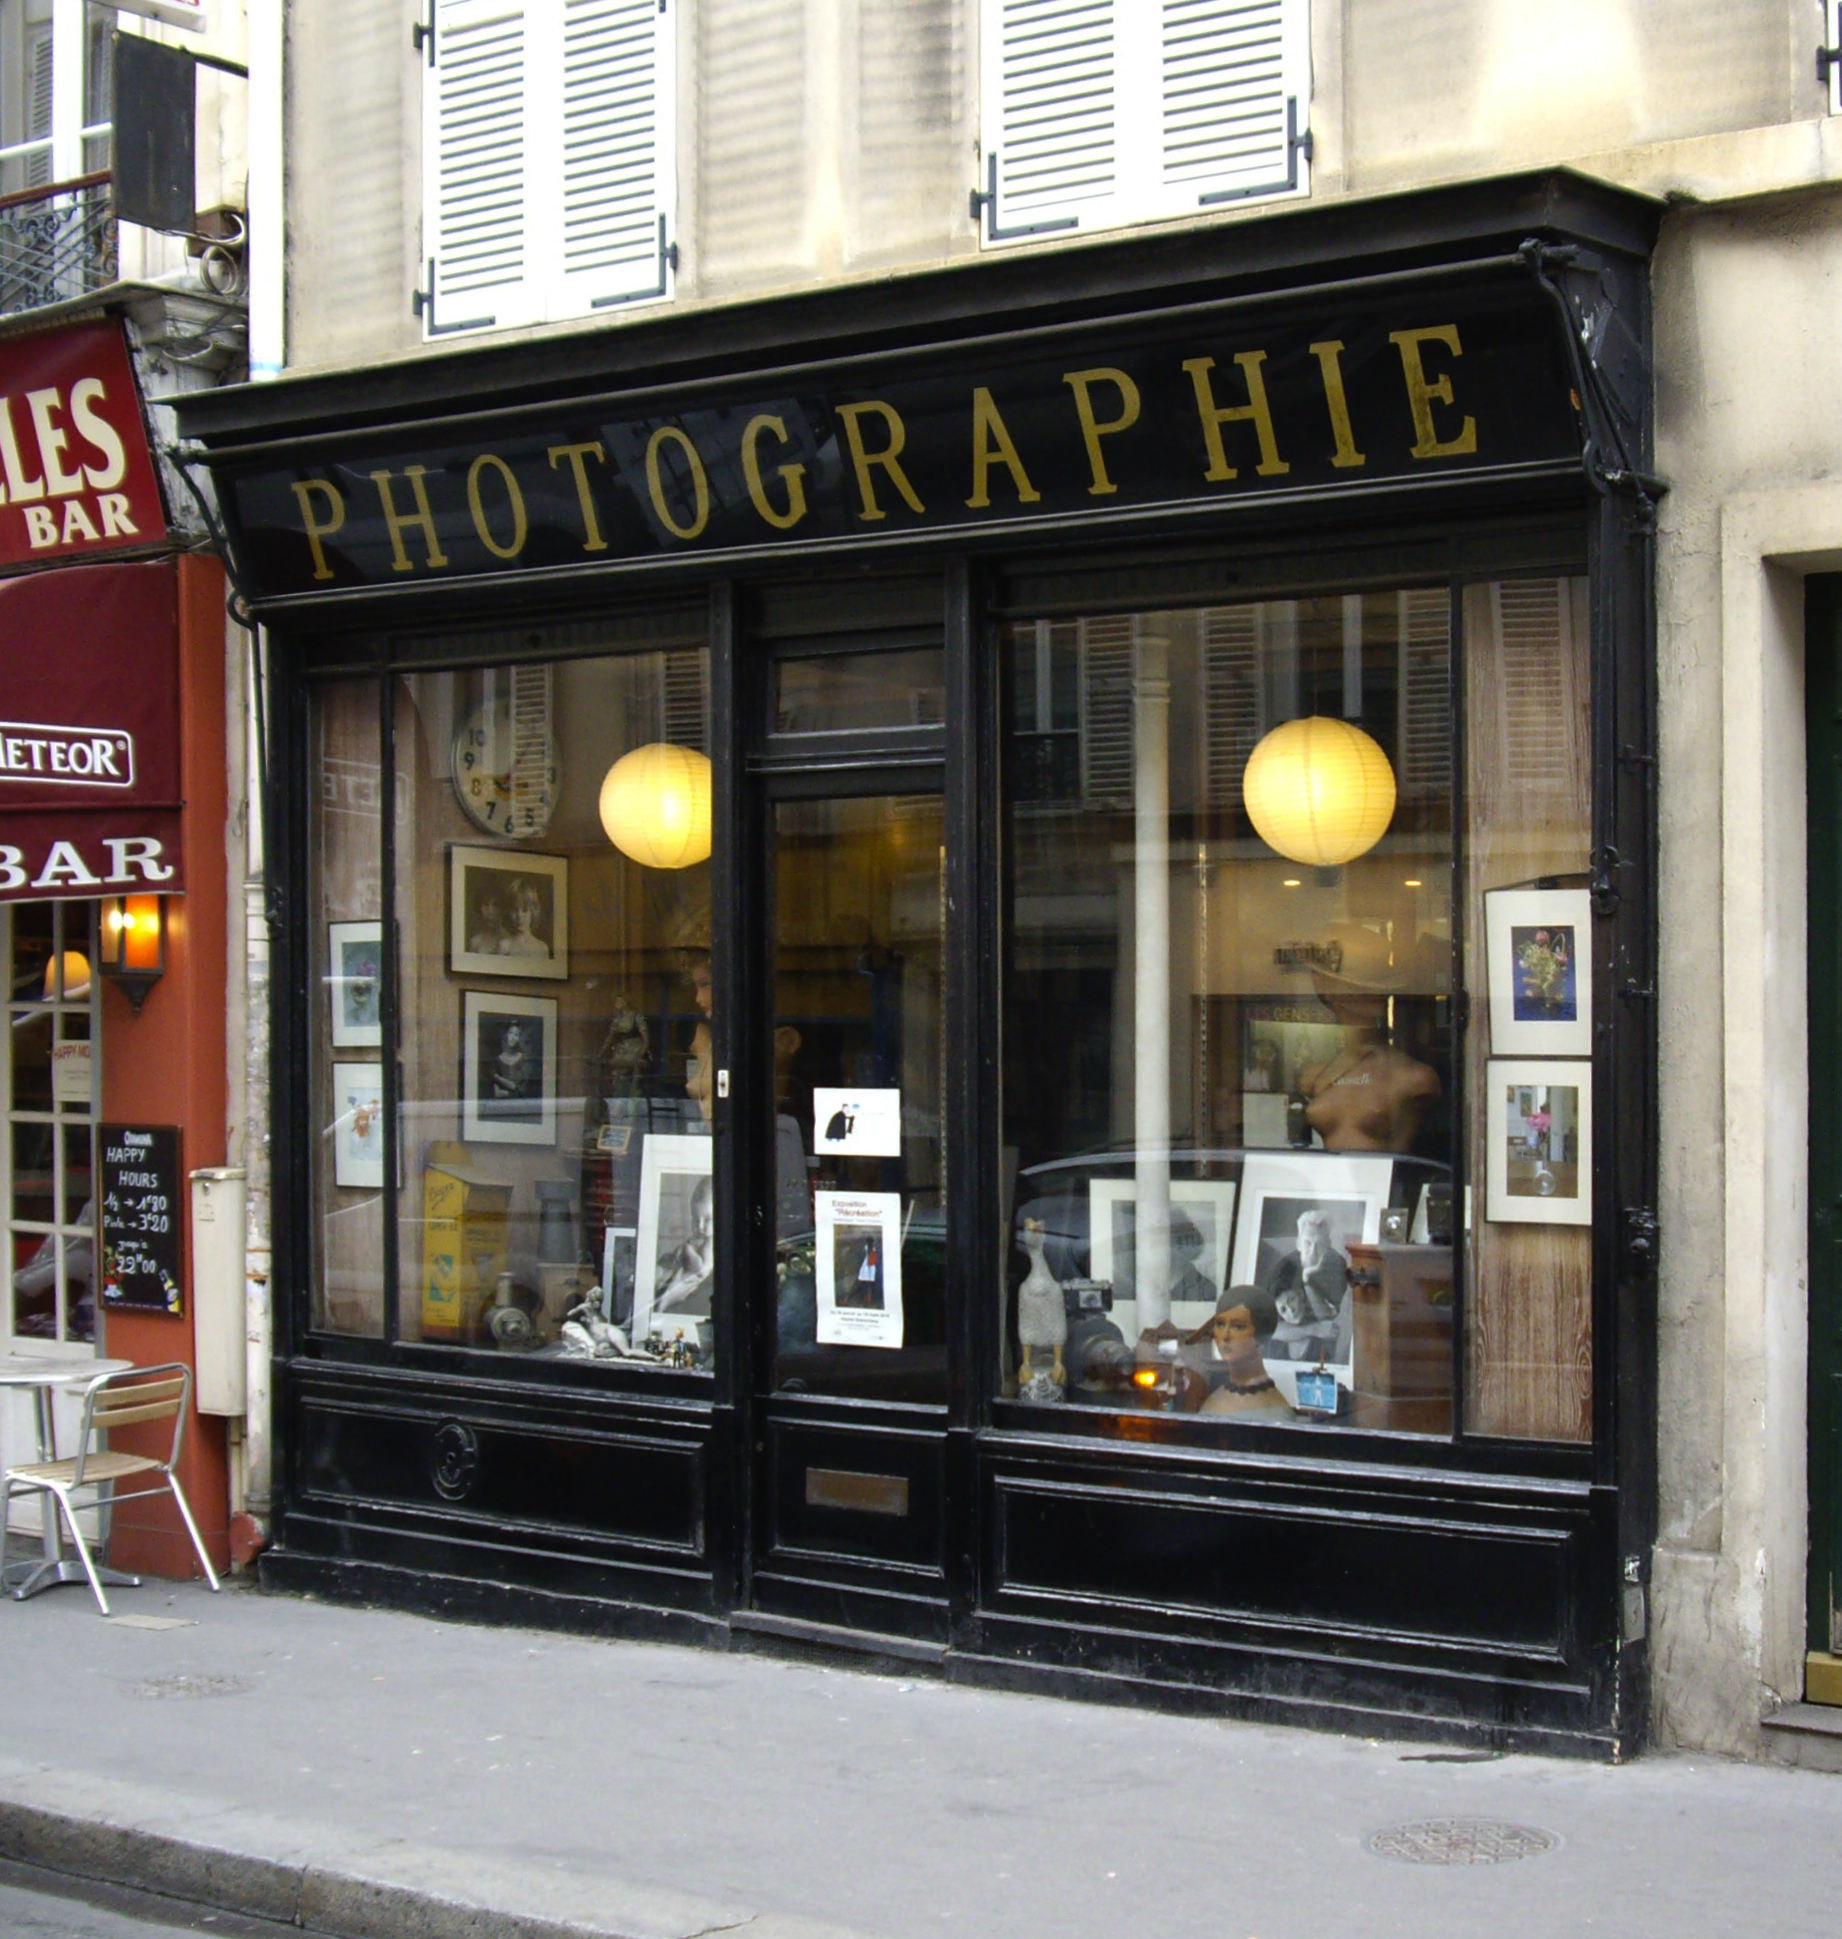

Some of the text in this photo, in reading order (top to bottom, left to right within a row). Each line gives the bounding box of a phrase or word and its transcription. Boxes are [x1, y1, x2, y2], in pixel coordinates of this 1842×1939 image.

[0, 377, 126, 504] LES
[291, 324, 1477, 580] PHOTOGRAPHIE
[23, 493, 139, 548] BAR
[0, 732, 120, 776] ETEOR
[0, 836, 174, 890] BAR
[106, 1147, 146, 1163] HAPPY
[119, 1171, 158, 1188] HOURS
